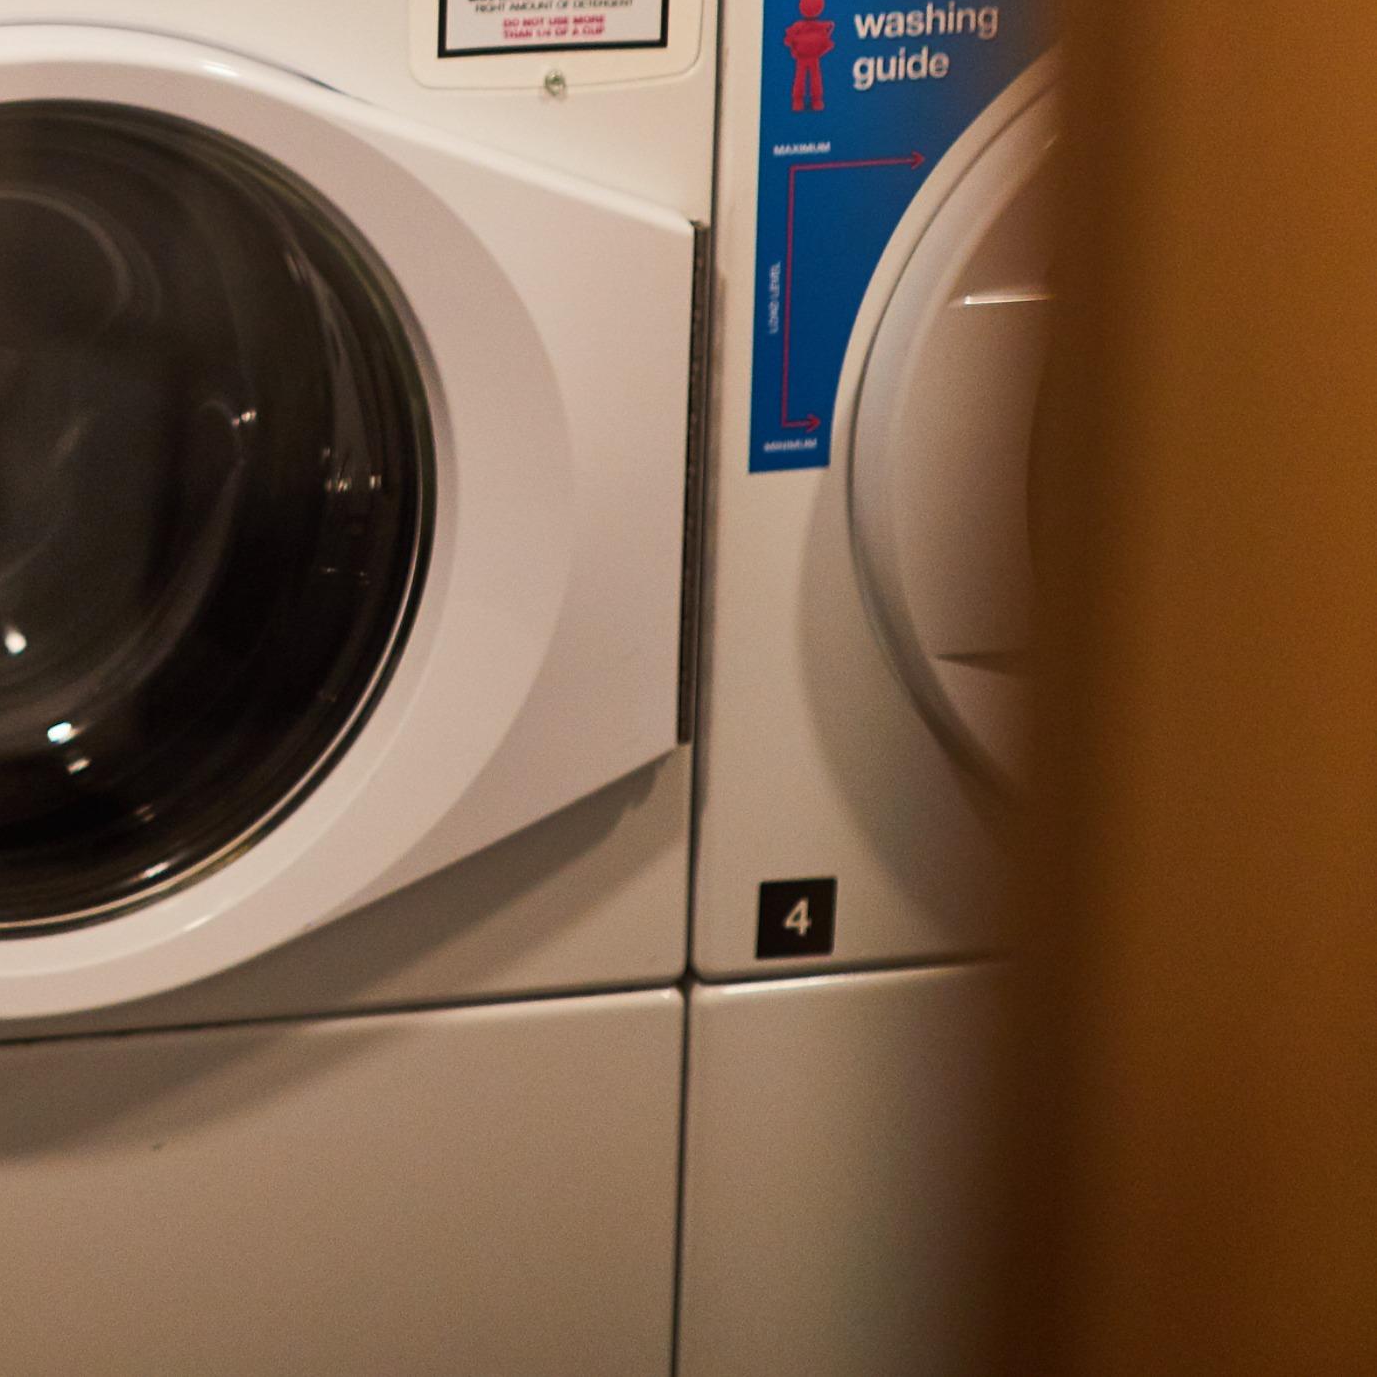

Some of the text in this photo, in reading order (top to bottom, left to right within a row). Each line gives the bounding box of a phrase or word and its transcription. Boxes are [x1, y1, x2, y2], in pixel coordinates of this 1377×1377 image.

[854, 2, 998, 39] washing
[852, 47, 949, 90] guide
[785, 897, 812, 936] 4
